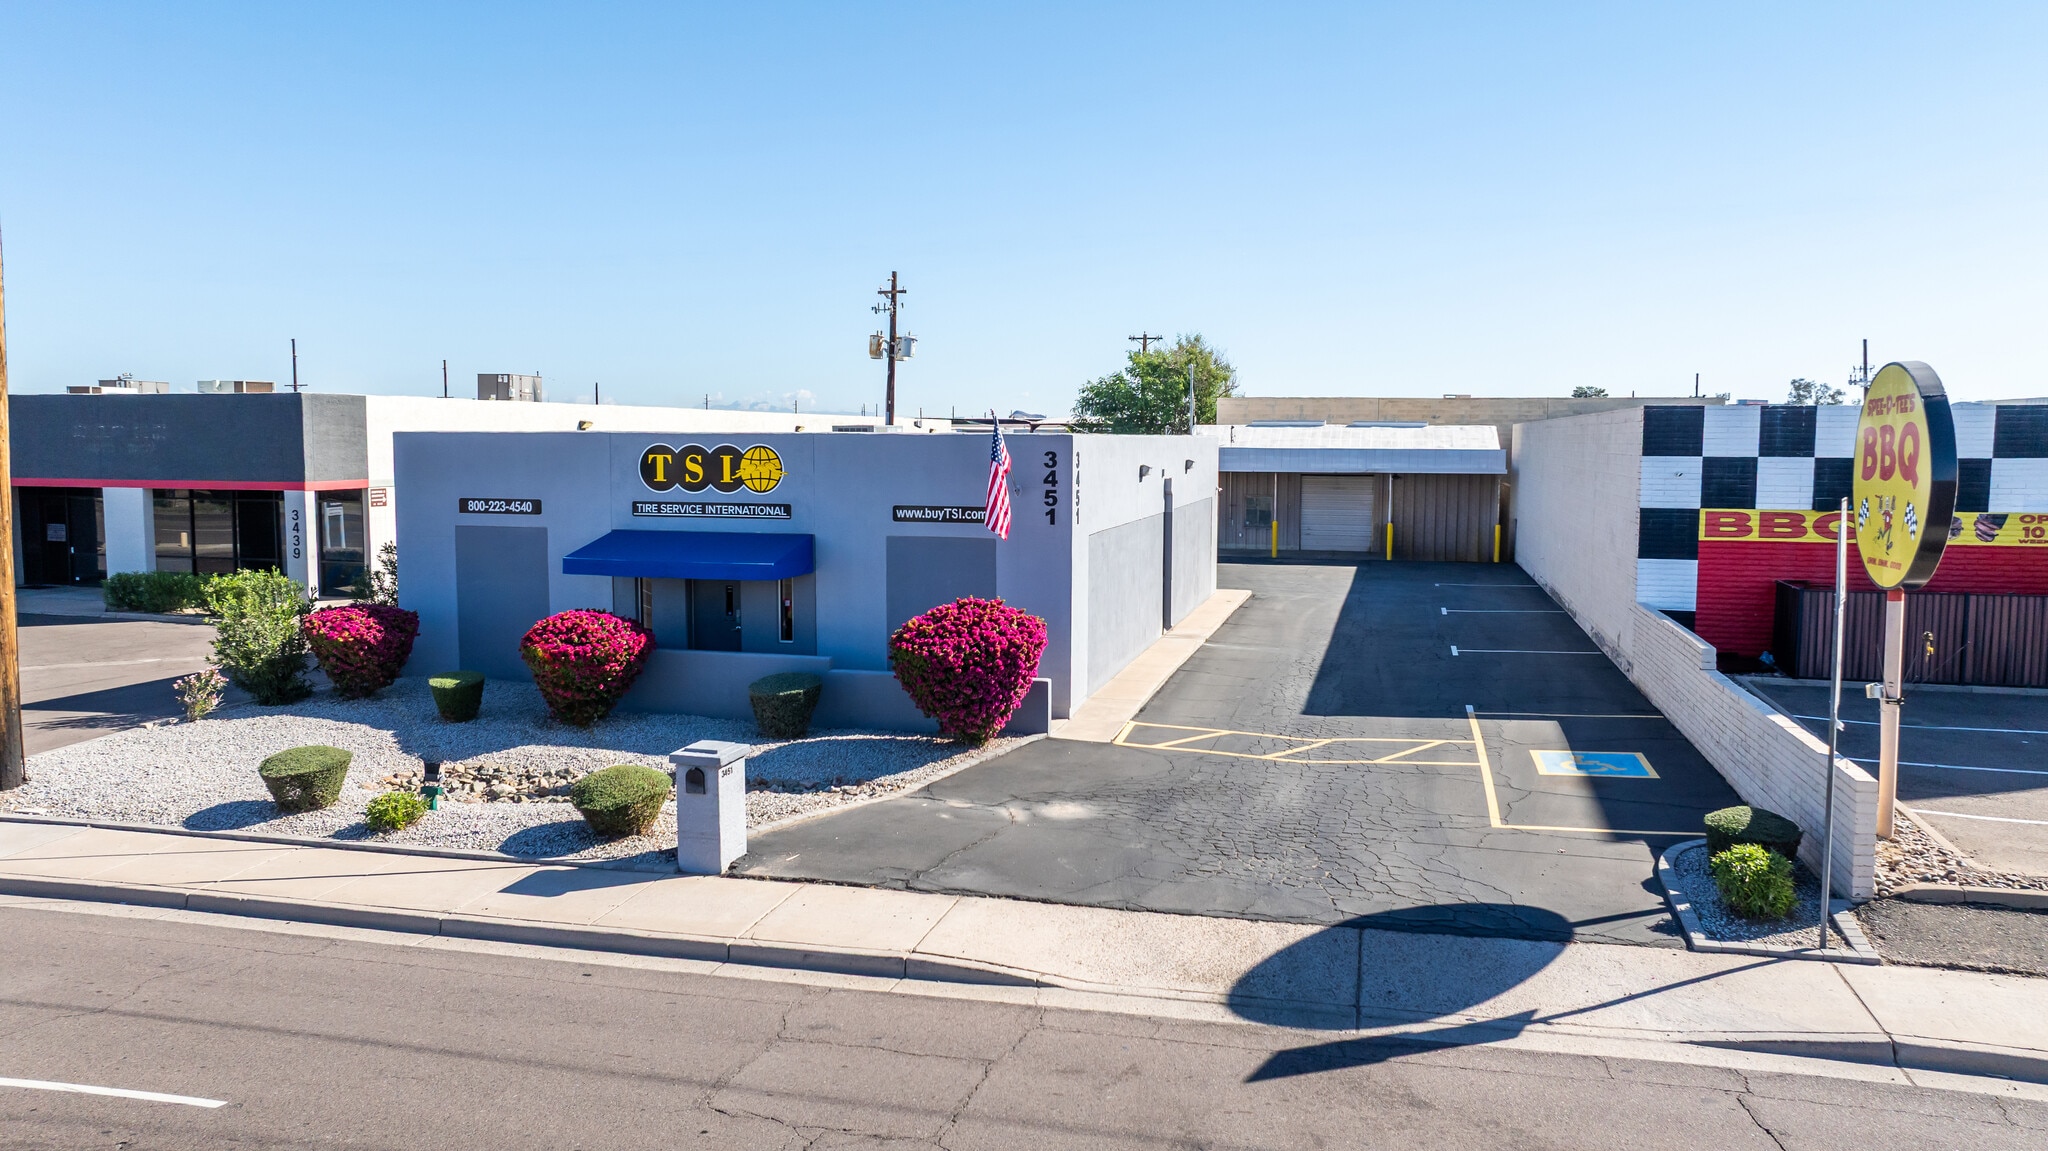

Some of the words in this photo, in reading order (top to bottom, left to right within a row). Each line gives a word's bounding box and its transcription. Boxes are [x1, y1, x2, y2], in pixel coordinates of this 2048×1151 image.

[1861, 421, 1920, 490] BBQ
[648, 454, 734, 483] TSI
[1043, 451, 1058, 525] 3451
[468, 500, 532, 512] 800-223-4540
[637, 503, 658, 513] TIRE
[660, 503, 702, 514] SERVICE
[705, 505, 787, 516] INTERNATIONAL
[291, 509, 300, 558] 3439
[2022, 526, 2045, 538] 10
[721, 767, 733, 777] 3451
